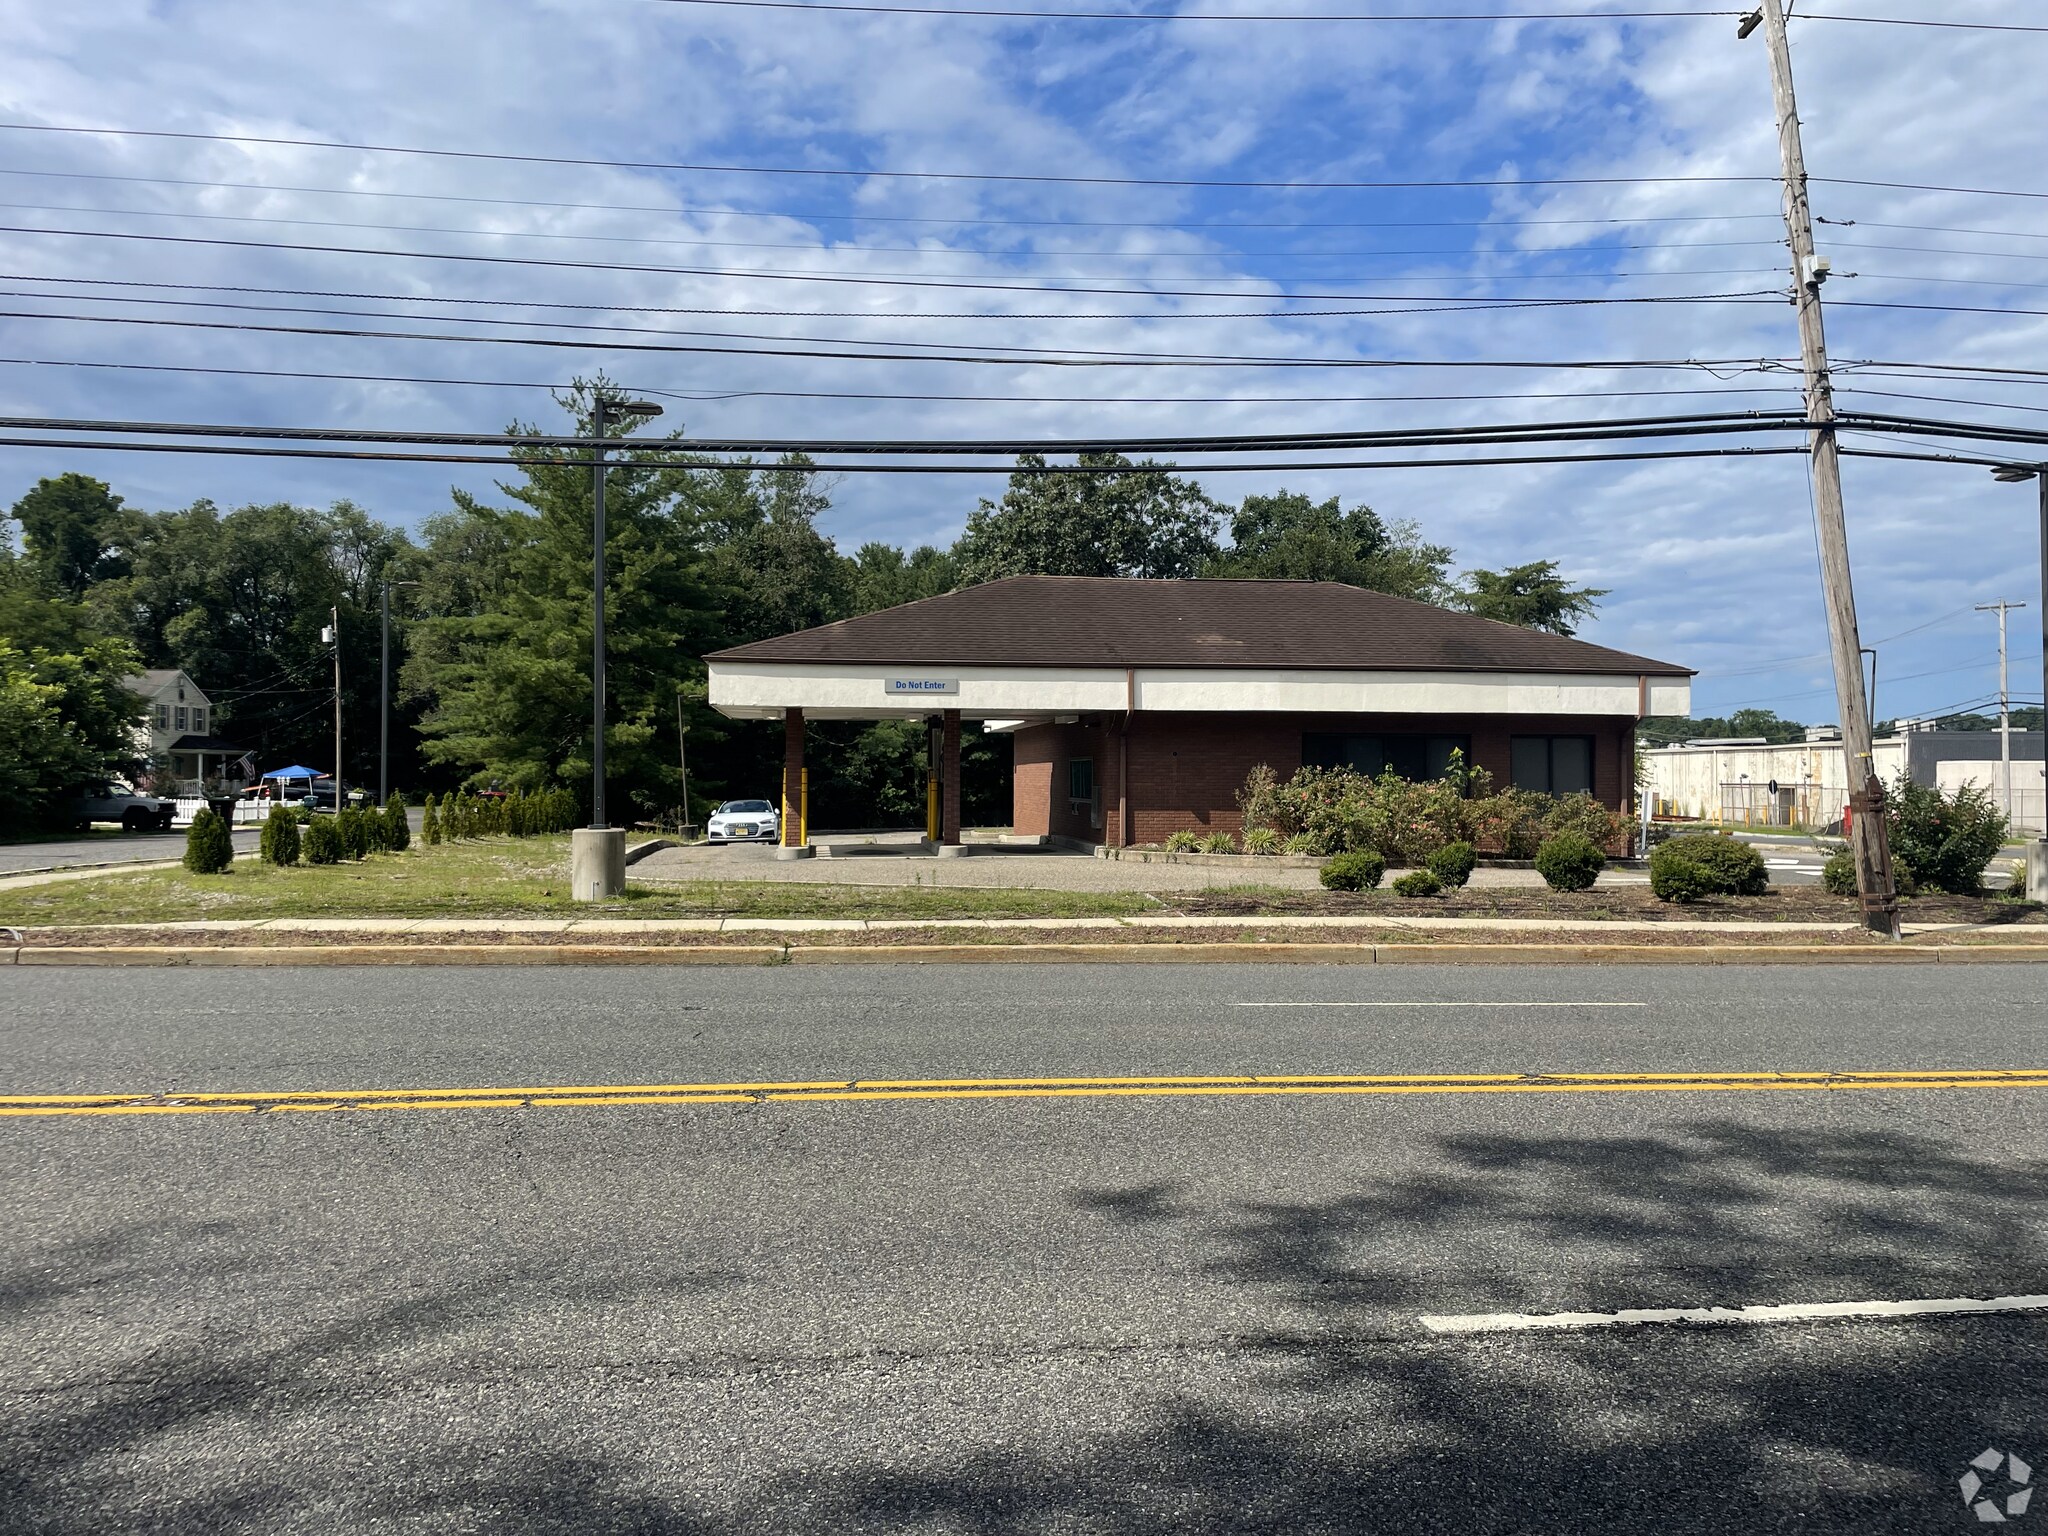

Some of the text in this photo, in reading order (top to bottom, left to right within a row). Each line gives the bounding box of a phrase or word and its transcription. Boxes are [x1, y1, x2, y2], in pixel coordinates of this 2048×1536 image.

[896, 681, 946, 689] Do Not Enter
